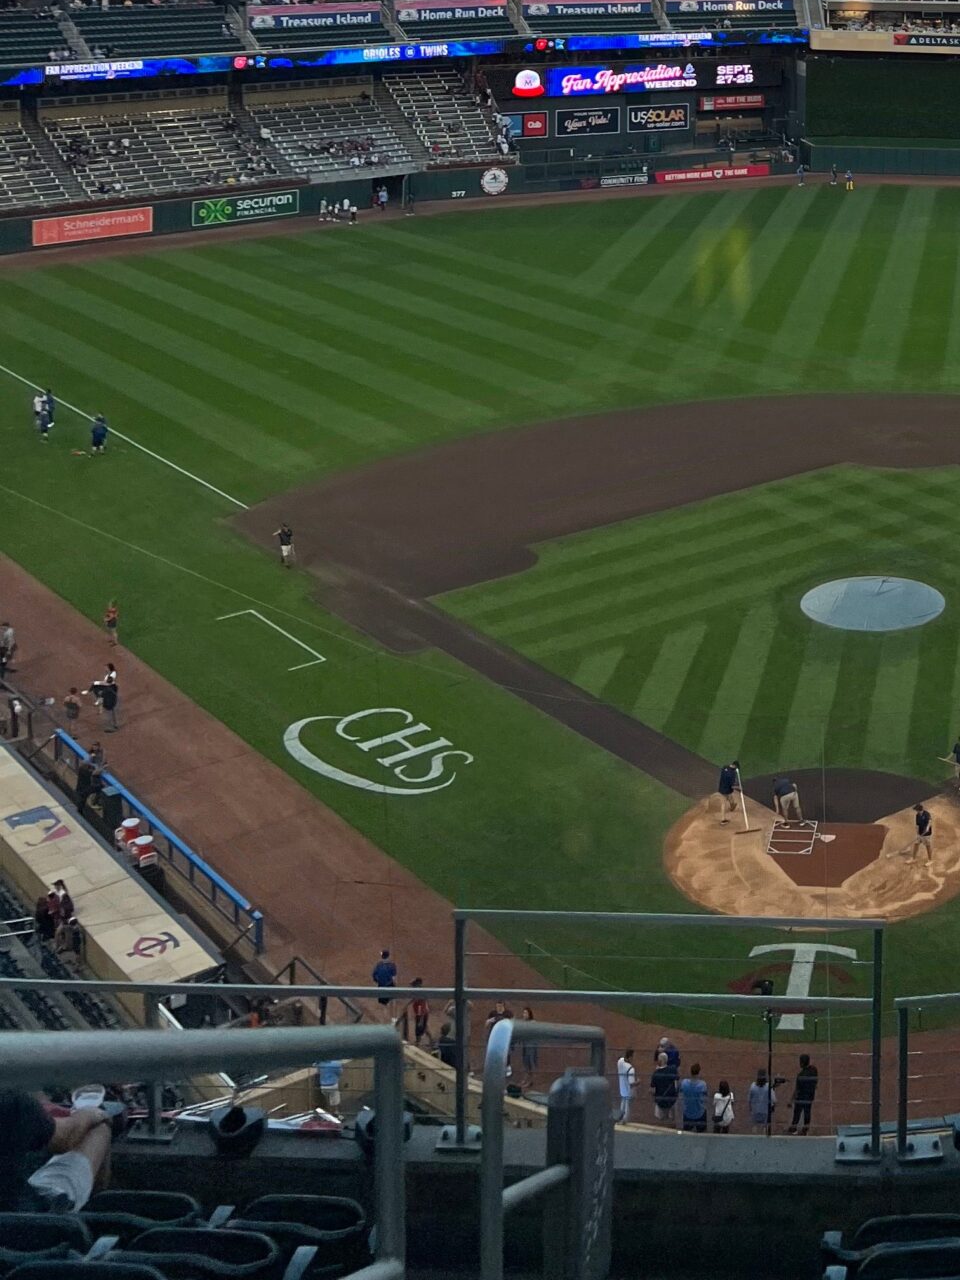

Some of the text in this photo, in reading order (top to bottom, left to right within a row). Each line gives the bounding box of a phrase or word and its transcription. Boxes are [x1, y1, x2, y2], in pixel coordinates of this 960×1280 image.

[555, 3, 642, 15] Treasure Island
[702, 0, 783, 11] Home Run Deck
[421, 6, 504, 20] Home Run Deck
[280, 13, 372, 28] Treasure Island
[918, 37, 948, 45] DELTA
[363, 47, 400, 60] ORIOLES
[420, 45, 448, 56] TWINS
[45, 66, 60, 75] FAN
[60, 63, 110, 73] APPRECIATION
[716, 64, 753, 75] SEPT.
[562, 64, 683, 95] Fan Appreciation
[644, 78, 698, 90] WEEKEND
[716, 74, 754, 85] 27-28
[646, 120, 685, 128] us-solar.com
[600, 176, 633, 185] COMMUNITY
[451, 190, 466, 198] 377
[235, 194, 293, 210] securian
[236, 207, 276, 216] FINANCIAL
[63, 213, 144, 231] Schneiderman's
[335, 707, 474, 783] CHS
